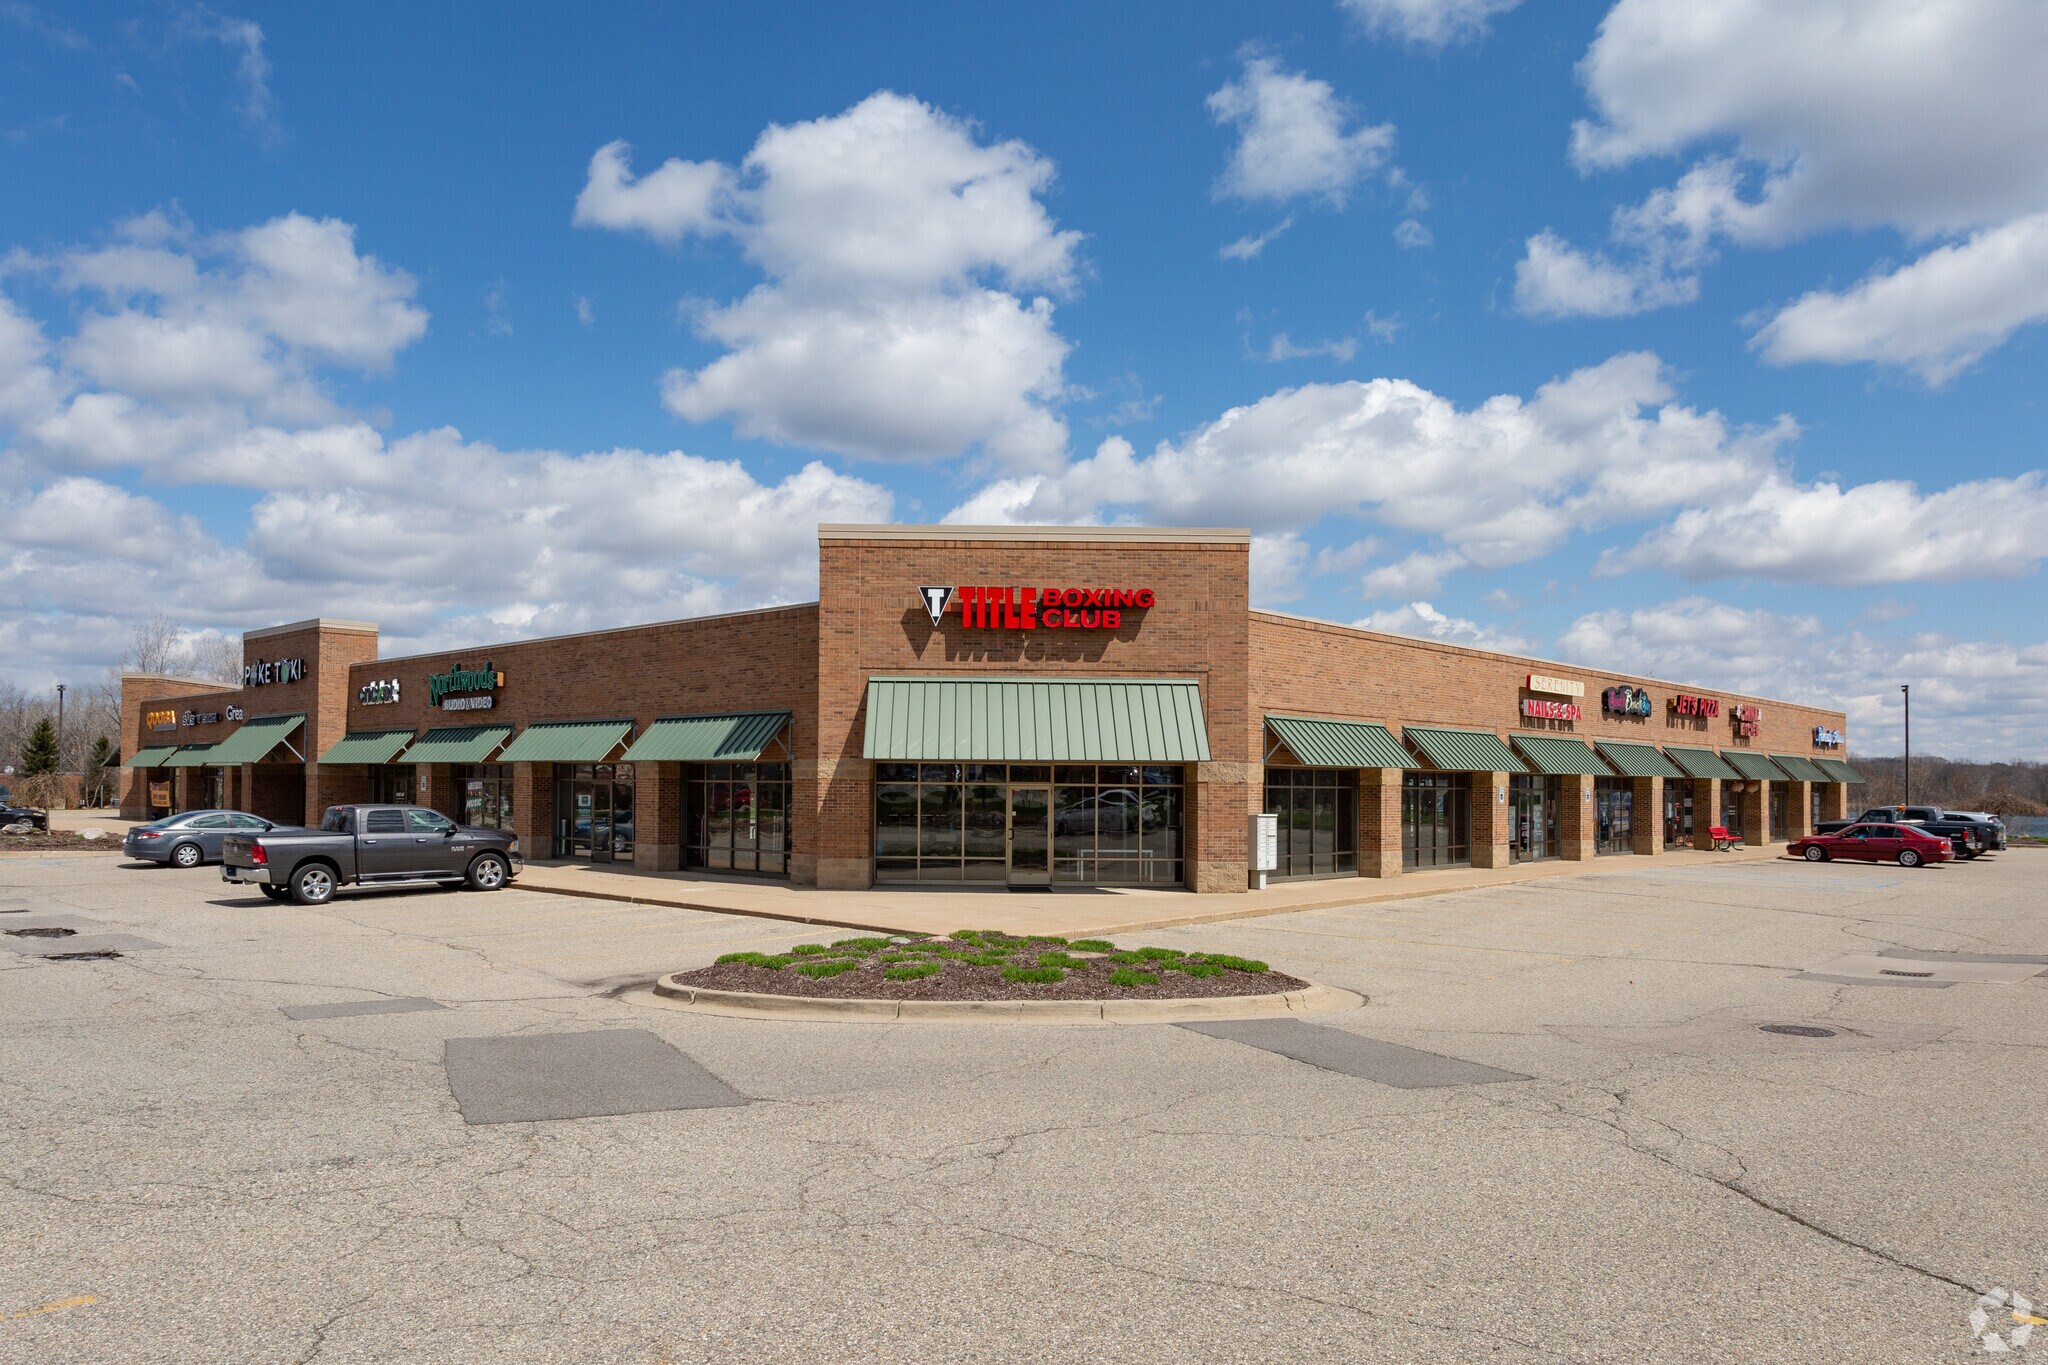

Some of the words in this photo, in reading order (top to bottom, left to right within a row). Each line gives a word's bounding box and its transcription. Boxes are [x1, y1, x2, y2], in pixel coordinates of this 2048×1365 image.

[958, 586, 1037, 629] TITLE
[1042, 588, 1155, 608] BOXING
[1042, 609, 1121, 629] CLUB
[357, 678, 400, 705] cricket
[429, 662, 496, 707] Northwoods
[1534, 676, 1581, 695] SERENITY
[443, 698, 465, 711] AUDIO
[471, 696, 493, 710] VIDEO
[1527, 699, 1554, 719] NAILS
[1556, 702, 1564, 719] &
[1565, 704, 1582, 721] SPA
[1677, 695, 1698, 715] JET'S
[1699, 698, 1719, 718] PIZZA
